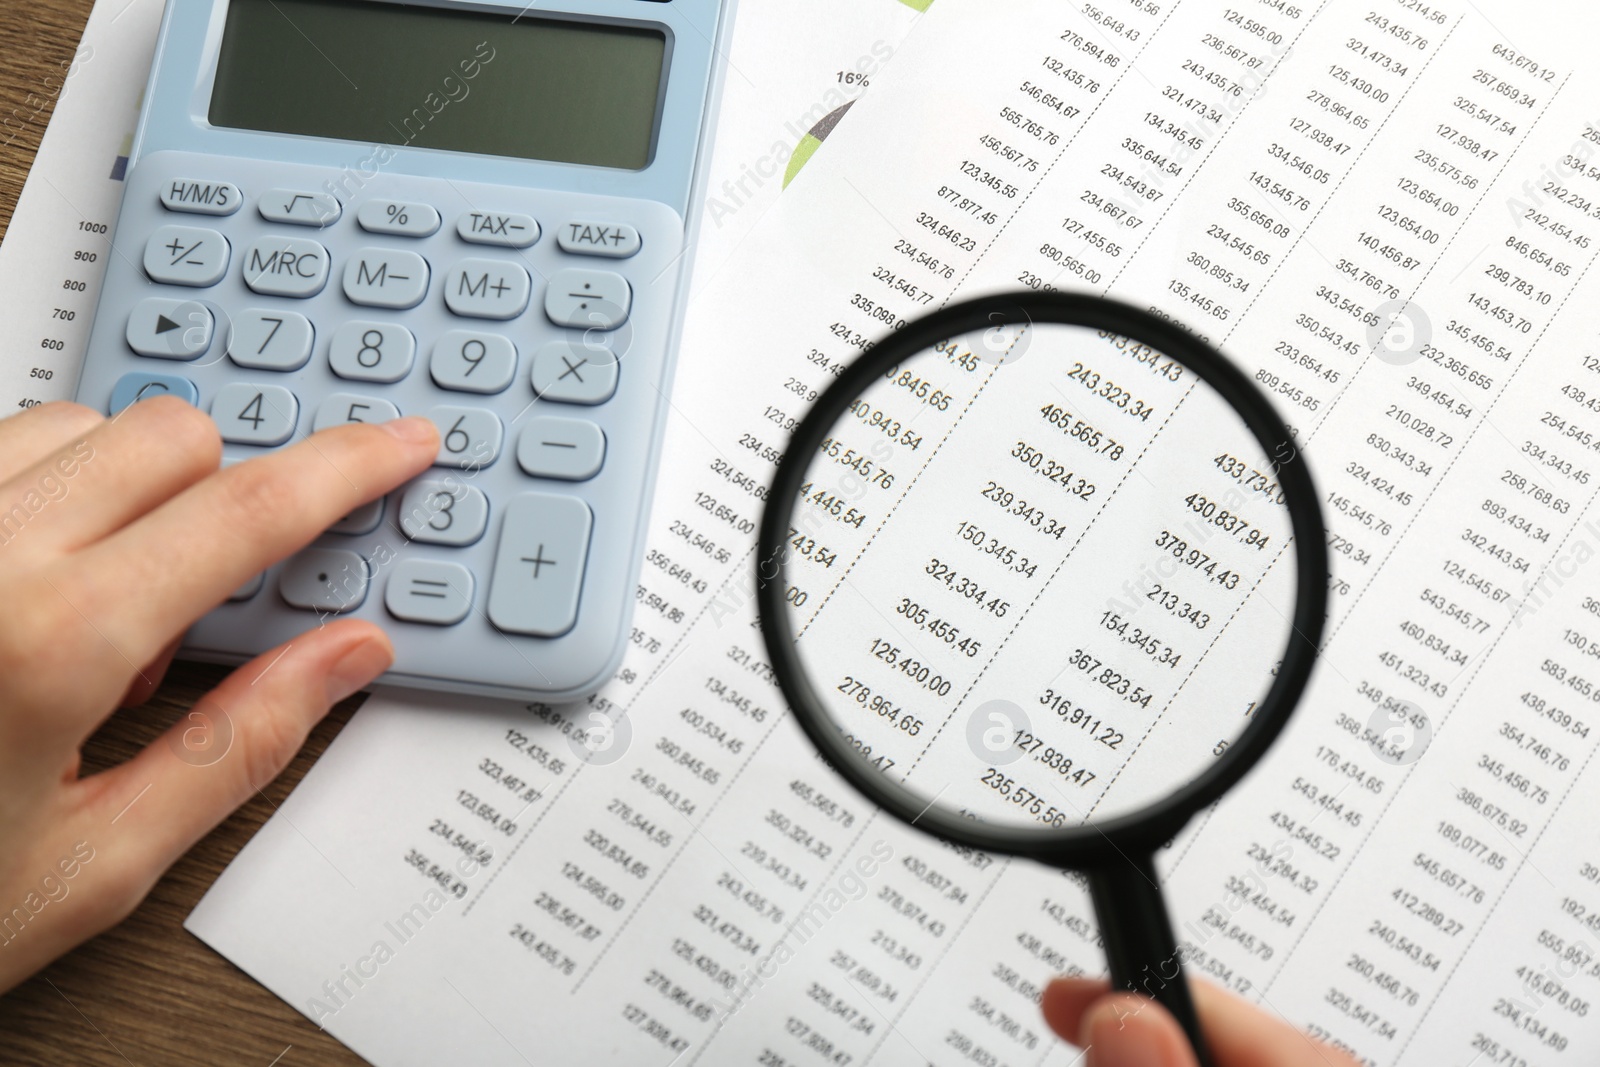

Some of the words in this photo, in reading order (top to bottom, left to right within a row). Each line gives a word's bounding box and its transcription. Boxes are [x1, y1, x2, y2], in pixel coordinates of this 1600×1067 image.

[1082, 4, 1140, 41] 356,648,43
[1223, 9, 1283, 46] 124,595,00
[1365, 12, 1428, 50] 243,435,76
[1060, 30, 1121, 69] 276,594,86
[1202, 34, 1263, 69] 236,567,87
[1347, 38, 1408, 76] 321,473,34
[1493, 44, 1555, 82] 643,679,12
[836, 70, 870, 88] 16%
[1043, 56, 1101, 95] 132,435,76
[1182, 60, 1243, 96] 243,435,76
[1329, 65, 1389, 103] 125,430,00
[1473, 70, 1536, 108] 257,659,34
[1020, 81, 1081, 120] 546,654,67
[1162, 86, 1222, 123] 321,473,34
[1307, 90, 1369, 129] 278,964,65
[1454, 97, 1516, 135] 325,547,54
[1000, 107, 1060, 146] 565,765,76
[1144, 113, 1203, 150] 134,345,45
[1290, 118, 1351, 155] 127,938,47
[1437, 124, 1498, 161] 127,938,47
[980, 134, 1039, 173] 456,567,75
[1122, 138, 1182, 176] 335,644,54
[1268, 144, 1330, 184] 334,546,05
[1415, 150, 1478, 189] 235,575,56
[170, 182, 230, 206] H/M/S
[960, 161, 1019, 200] 123,345,55
[1101, 164, 1163, 201] 234,543,87
[1250, 172, 1310, 211] 143,545,76
[1398, 178, 1459, 216] 123,654,00
[938, 186, 998, 226] 877,877,45
[1080, 191, 1143, 228] 234,667,67
[1228, 198, 1290, 238] 355,656,08
[1378, 205, 1439, 244] 123,654,00
[79, 221, 107, 234] 1000
[570, 223, 626, 246] TAX+
[916, 212, 977, 252] 324,646,23
[1062, 218, 1122, 257] 127,455,65
[1207, 224, 1270, 265] 234,545,65
[1525, 209, 1590, 248] 242,454,45
[74, 250, 97, 263] 900
[250, 248, 319, 279] MRC
[894, 240, 956, 279] 234,546,76
[1040, 243, 1101, 285] 890,565,00
[1358, 232, 1420, 270] 140,456,87
[1506, 236, 1571, 276] 846,654,65
[63, 279, 86, 292] 800
[459, 270, 512, 299] M+
[873, 266, 934, 306] 324,545,77
[1187, 252, 1249, 292] 360,895,34
[1336, 259, 1399, 299] 354,766,76
[1485, 264, 1551, 305] 299,783,10
[52, 308, 75, 321] 700
[1169, 279, 1230, 321] 135,445,65
[1316, 286, 1381, 327] 343,545,65
[1469, 293, 1531, 333] 143,453,70
[41, 338, 64, 351] 600
[258, 317, 284, 355] 7
[356, 330, 384, 369] 8
[1296, 314, 1360, 355] 350,543,45
[1446, 320, 1512, 361] 345,456,54
[30, 367, 53, 380] 500
[461, 339, 487, 378] 9
[1275, 341, 1340, 383] 233,654,45
[1420, 344, 1493, 389] 232,365,655
[1067, 363, 1153, 422] 243,323,34
[1256, 369, 1320, 411] 809,545,85
[1407, 377, 1472, 419] 349,454,54
[237, 393, 266, 431] 4
[1386, 405, 1453, 448] 210,028,72
[444, 414, 471, 454] 6
[1041, 404, 1124, 461] 465,565,78
[1011, 442, 1095, 501] 350,324,32
[1367, 434, 1432, 476] 830,343,34
[1522, 441, 1590, 484] 334,343,45
[1346, 462, 1412, 505] 324,424,45
[1501, 470, 1570, 513] 258,768,63
[428, 490, 456, 531] 3
[695, 492, 754, 534] 123,654,00
[981, 481, 1066, 540] 239,343,34
[1185, 494, 1269, 551] 430,837,94
[1328, 492, 1391, 535] 145,545,76
[1482, 500, 1550, 543] 893,434,34
[669, 520, 732, 564] 234,546,56
[957, 522, 1037, 578] 150,345,34
[1155, 531, 1239, 590] 378,974,43
[1462, 529, 1530, 573] 342,443,54
[646, 550, 708, 594] 356,648,43
[926, 559, 1010, 617] 324,334,45
[1444, 561, 1510, 603] 124,545,67
[1146, 584, 1210, 629] 213,343
[1421, 589, 1490, 633] 543,545,77
[897, 598, 982, 657] 305,455,45
[1100, 611, 1181, 668] 154,345,34
[1400, 621, 1468, 666] 460,834,34
[871, 638, 951, 696] 125,430,00
[1069, 649, 1152, 709] 367,823,54
[1379, 652, 1447, 697] 451,323,43
[837, 676, 923, 736] 278,964,65
[1040, 689, 1124, 750] 316,911,22
[1521, 693, 1589, 738] 438,439,54
[1013, 729, 1096, 787] 127,938,47
[1500, 723, 1569, 771] 354,746,76
[981, 768, 1067, 829] 235,575,56
[1478, 755, 1548, 804] 345,456,75
